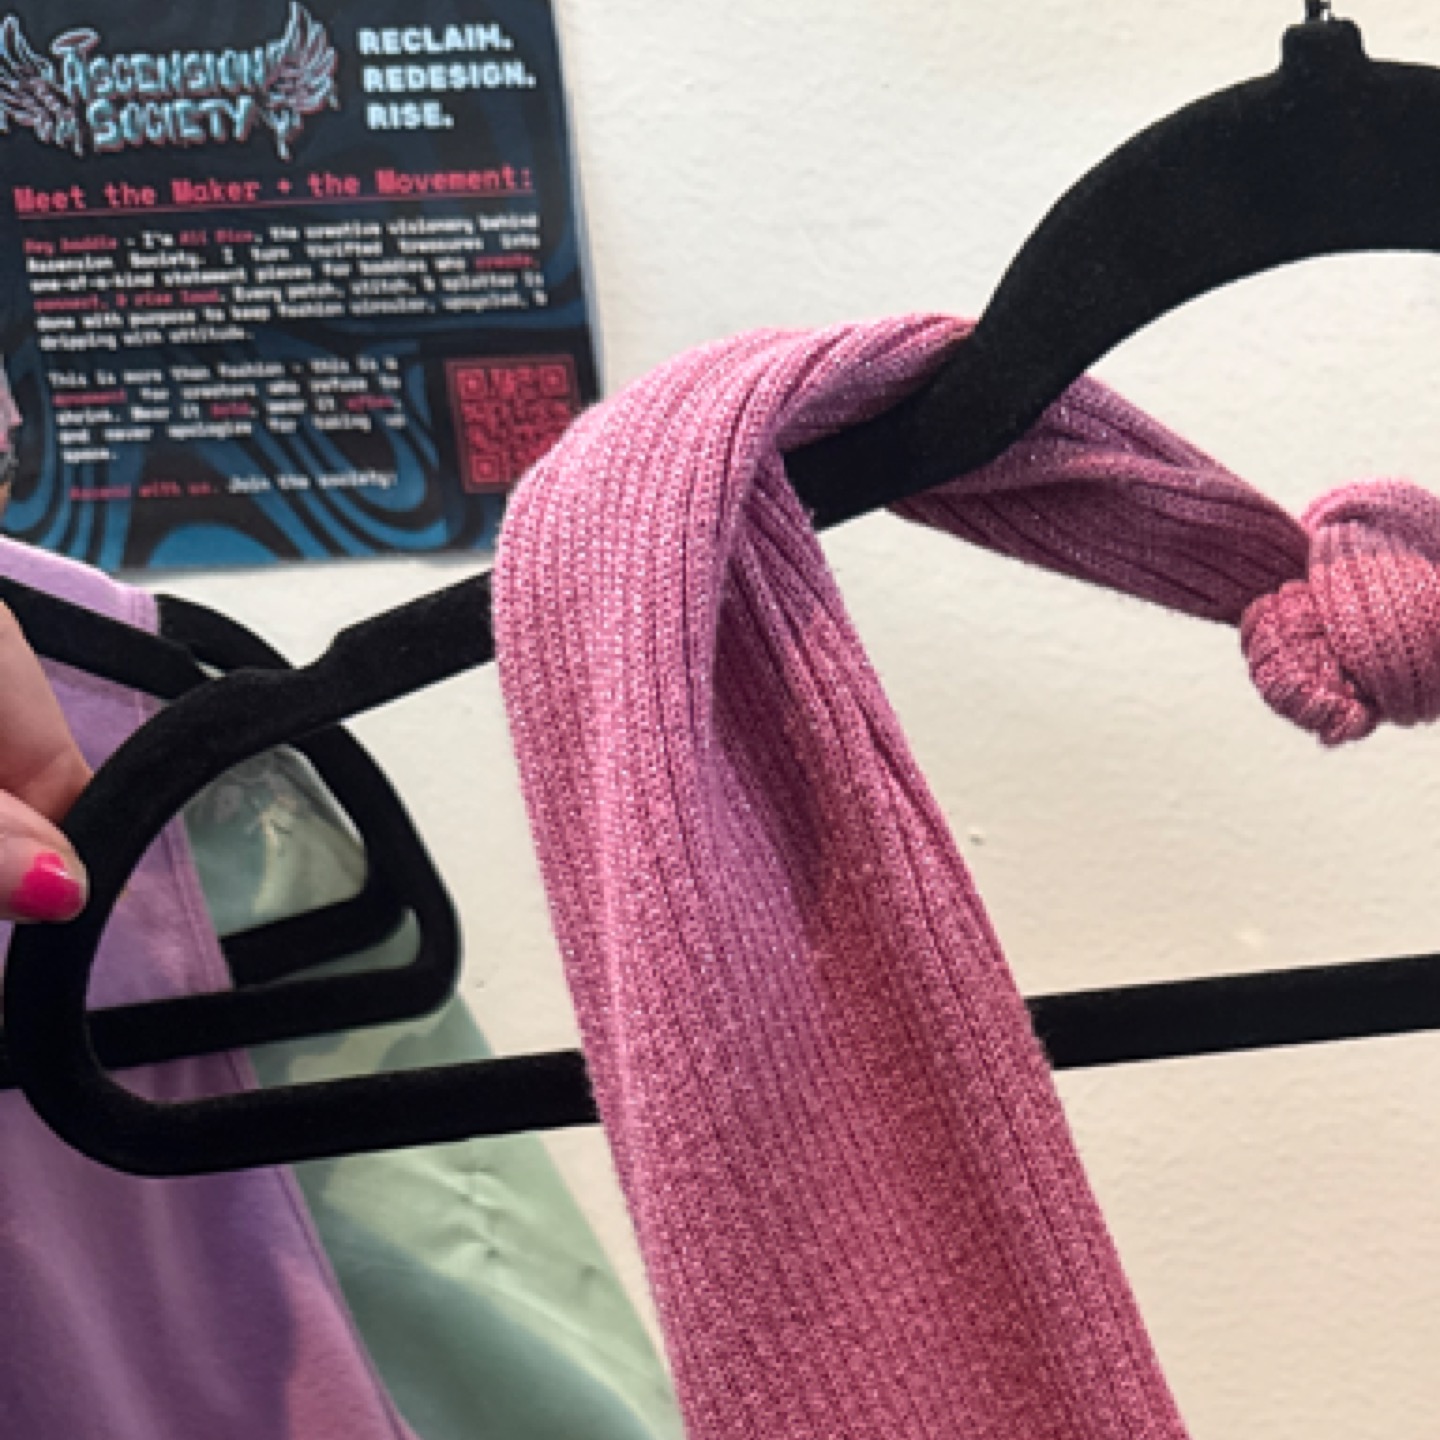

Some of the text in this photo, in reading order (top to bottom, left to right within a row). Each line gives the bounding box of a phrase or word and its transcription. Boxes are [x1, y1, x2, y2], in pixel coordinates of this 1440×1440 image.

[357, 24, 514, 56] RECLAIM.
[61, 43, 268, 98] ASCENSION
[362, 60, 537, 93] REDESIGN.
[87, 97, 254, 152] SOCIETY
[366, 101, 455, 130] RISE.
[13, 184, 86, 213] Meet
[103, 181, 157, 208] the
[170, 178, 261, 205] Maker
[307, 171, 360, 198] the
[375, 163, 533, 194] Movement:
